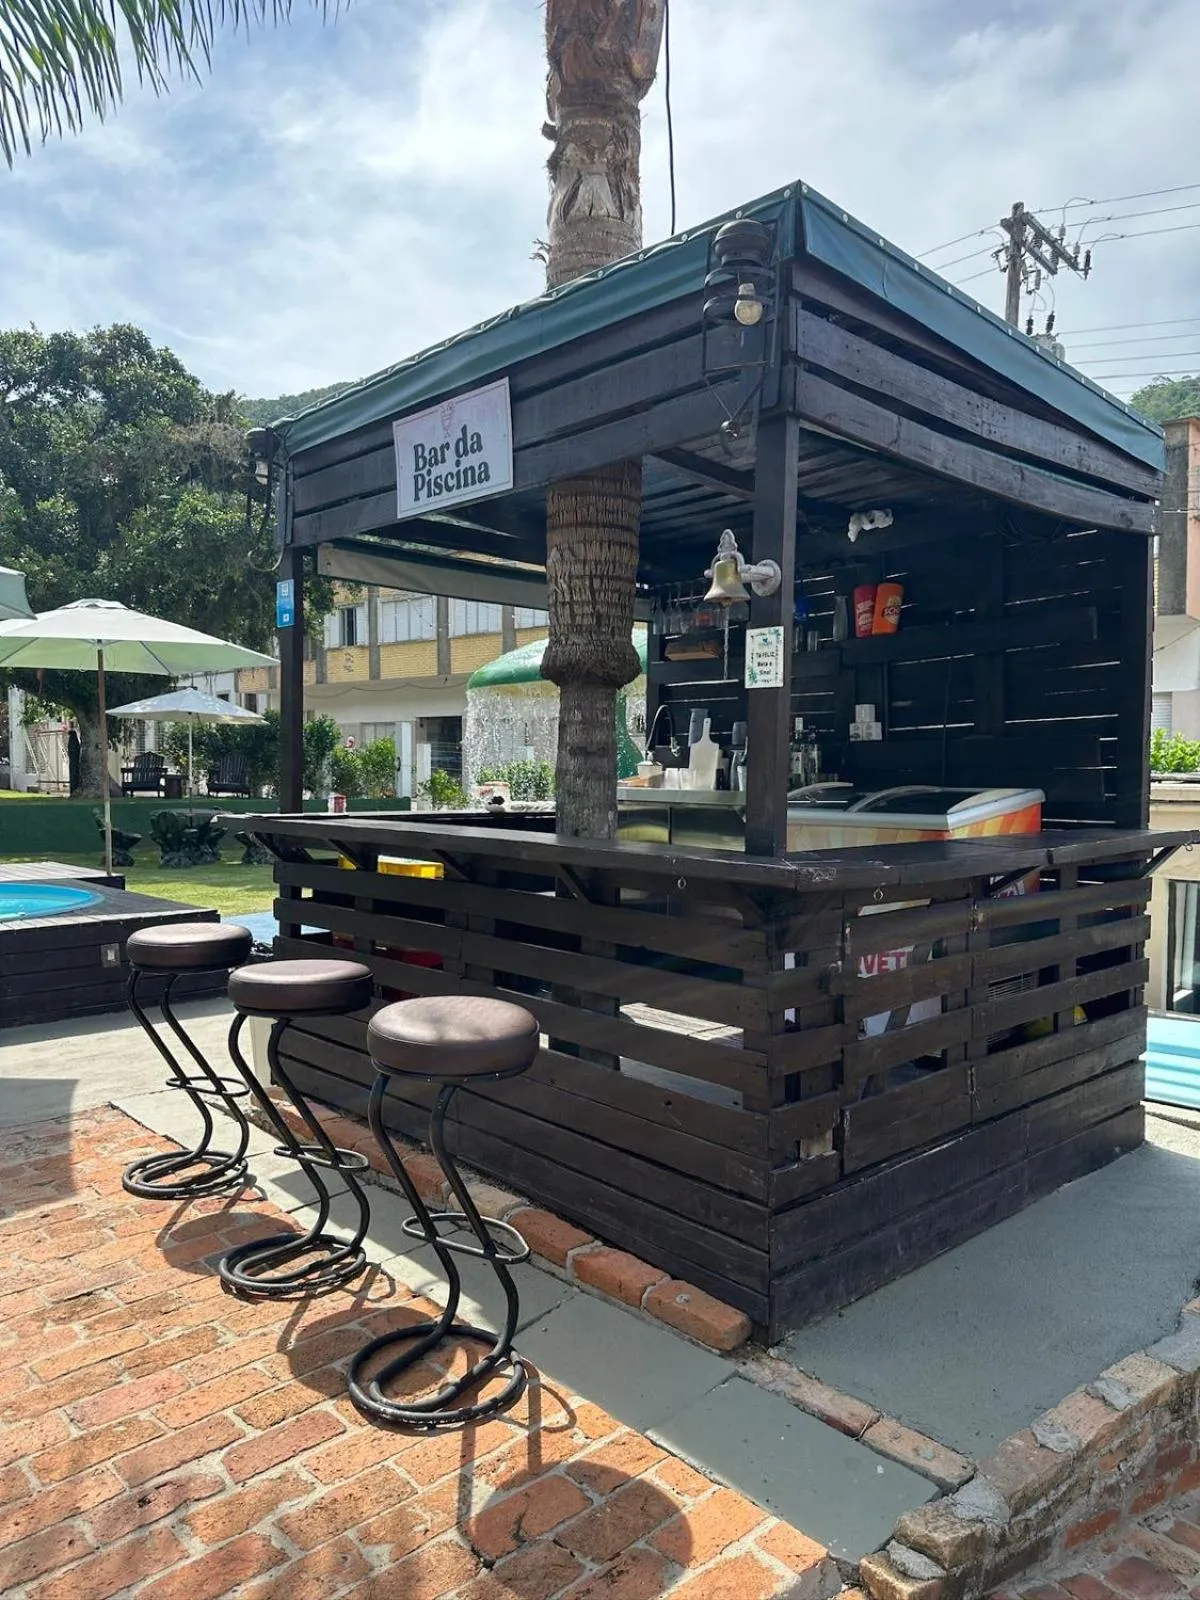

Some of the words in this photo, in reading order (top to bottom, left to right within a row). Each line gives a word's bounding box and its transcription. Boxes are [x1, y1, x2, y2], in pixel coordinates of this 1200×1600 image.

[413, 441, 450, 473] Bar
[454, 424, 483, 458] da
[413, 460, 490, 502] Piscina
